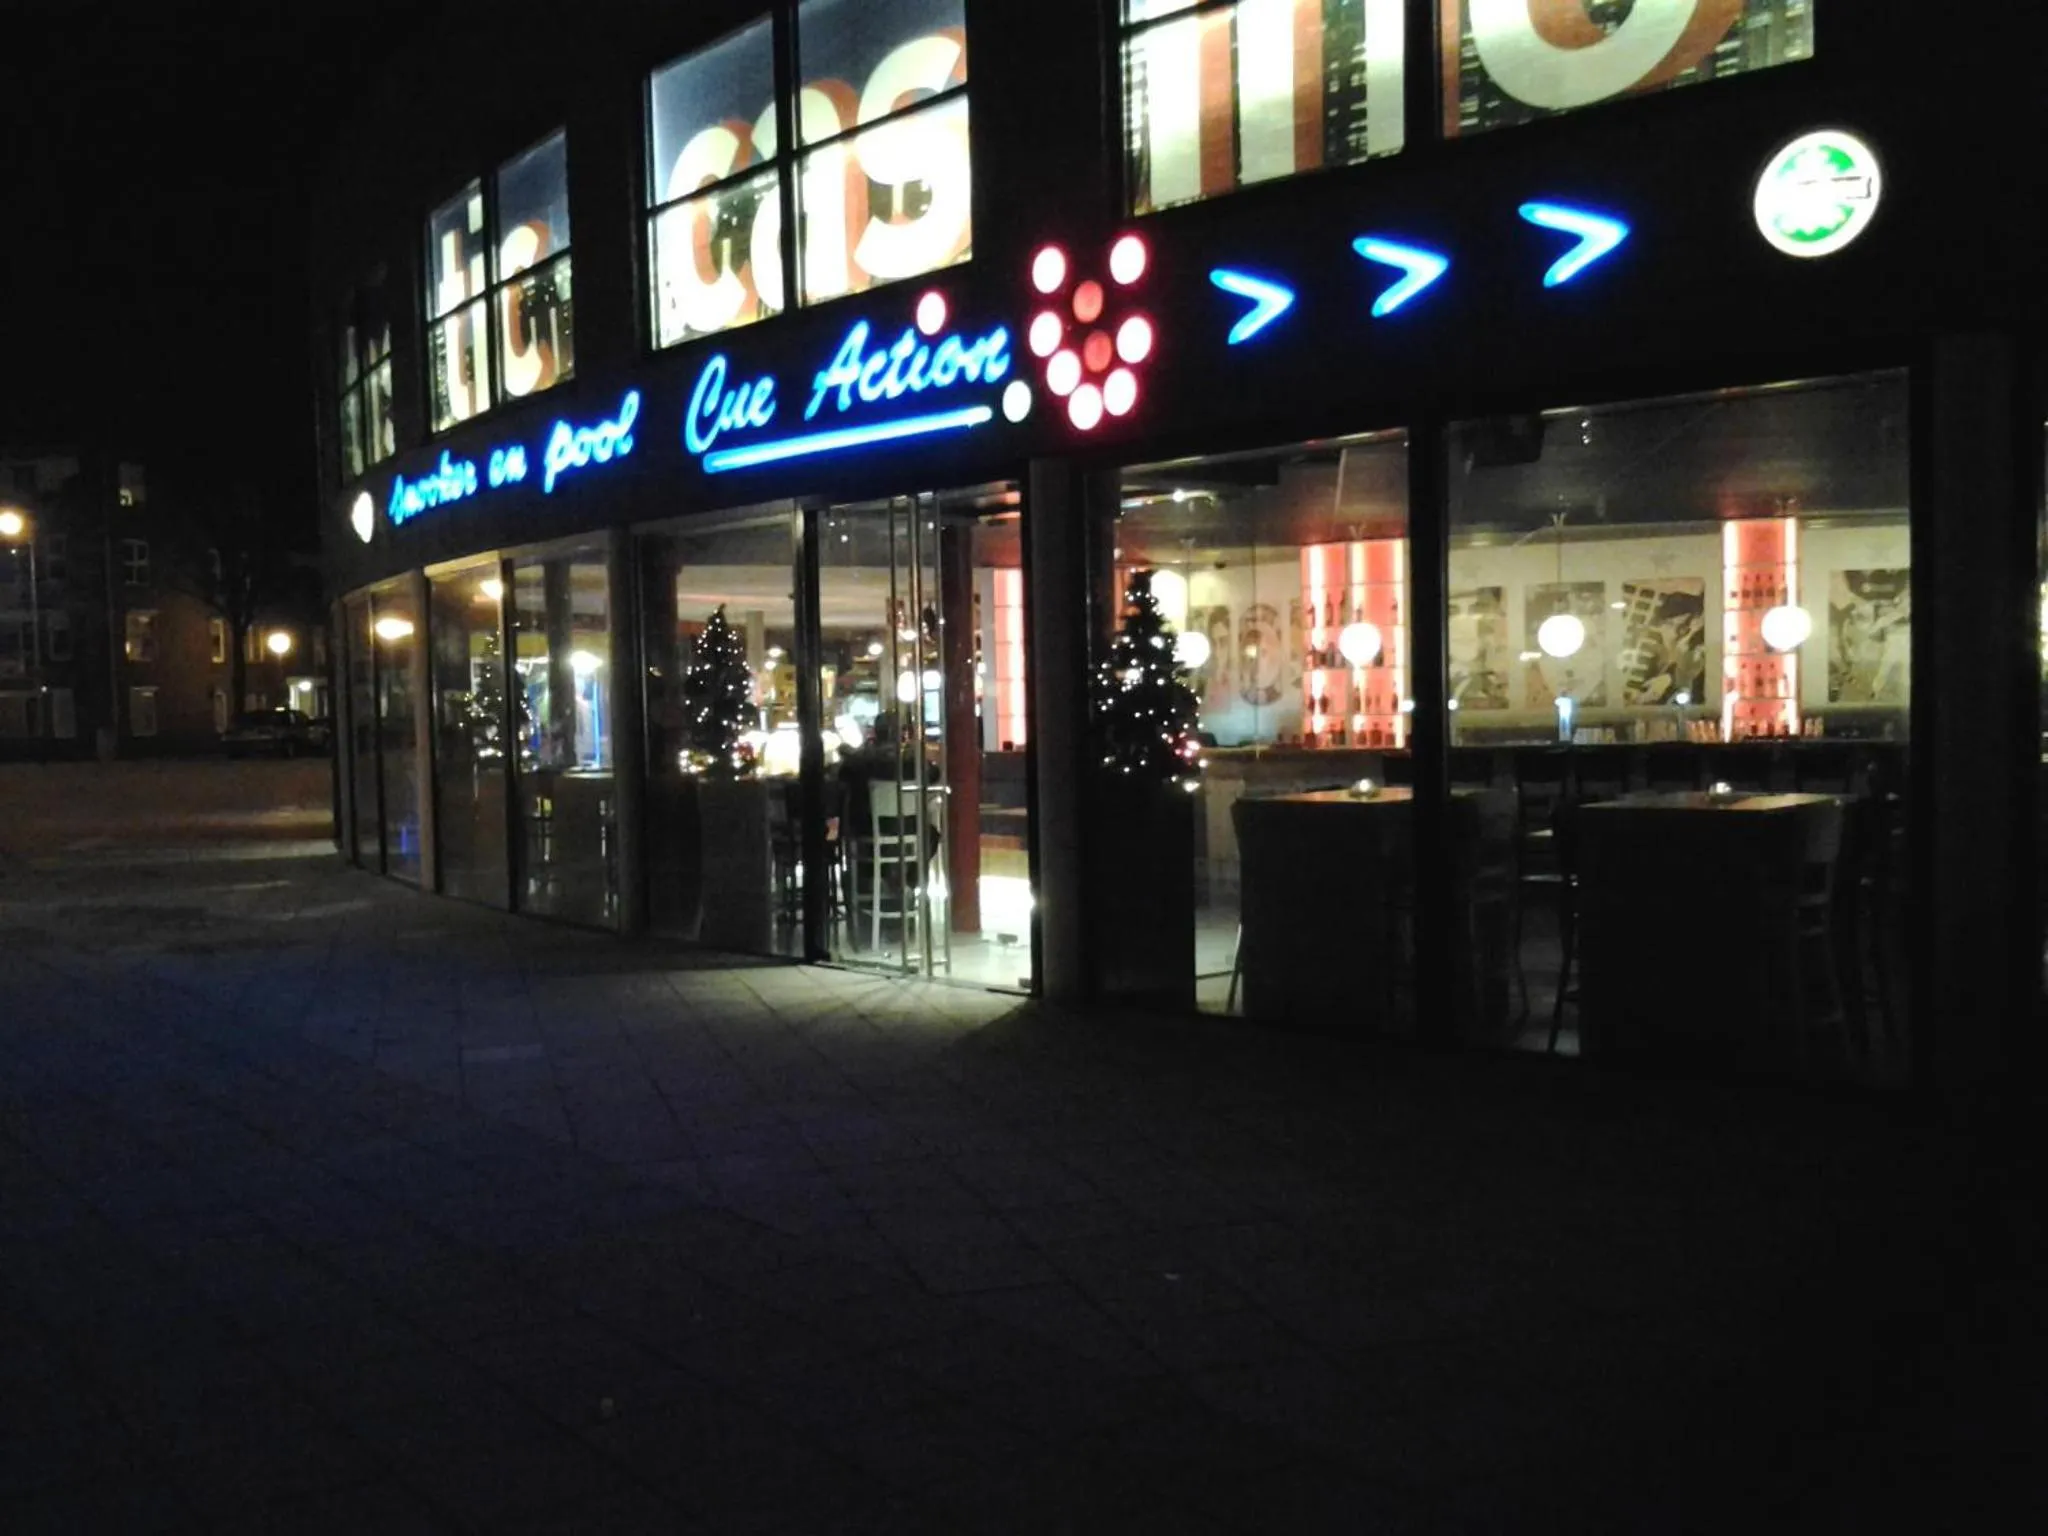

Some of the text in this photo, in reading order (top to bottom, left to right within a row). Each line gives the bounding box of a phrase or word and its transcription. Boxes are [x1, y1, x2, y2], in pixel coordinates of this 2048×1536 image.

[489, 445, 527, 488] en
[544, 390, 639, 494] pool
[685, 319, 1010, 454] Cue Action
